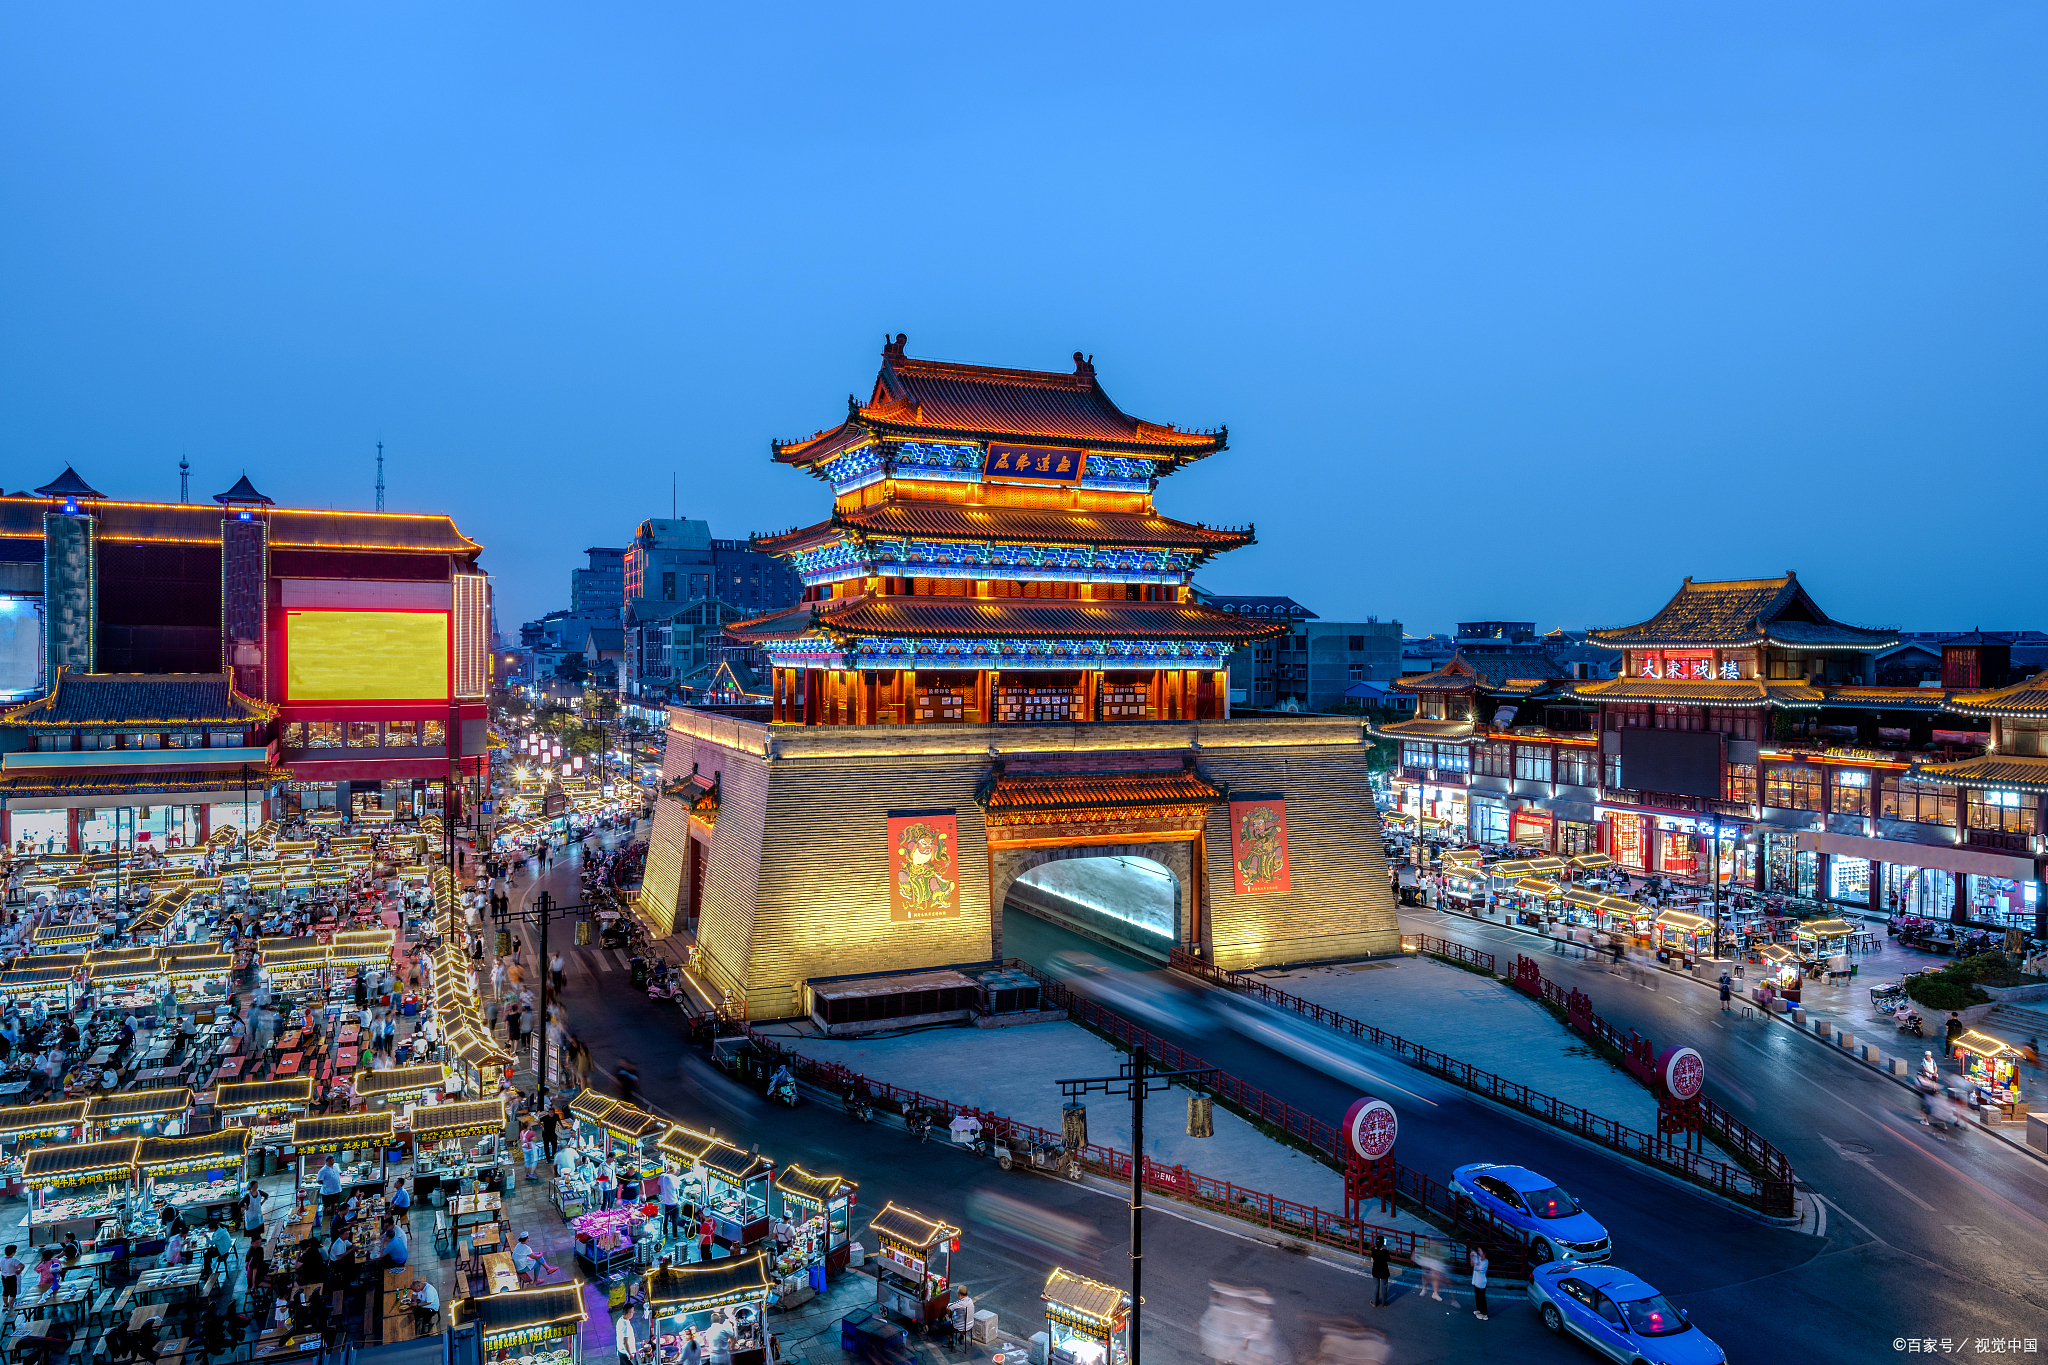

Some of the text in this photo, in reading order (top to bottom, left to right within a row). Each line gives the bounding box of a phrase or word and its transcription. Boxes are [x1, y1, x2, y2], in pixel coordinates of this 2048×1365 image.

[1639, 659, 1740, 680] 大宋戏楼
[342, 1140, 369, 1151] 羊头肉
[372, 1138, 391, 1147] 花生
[51, 1177, 78, 1188] 涮牛肚
[77, 1173, 104, 1186] 黄焖鱼
